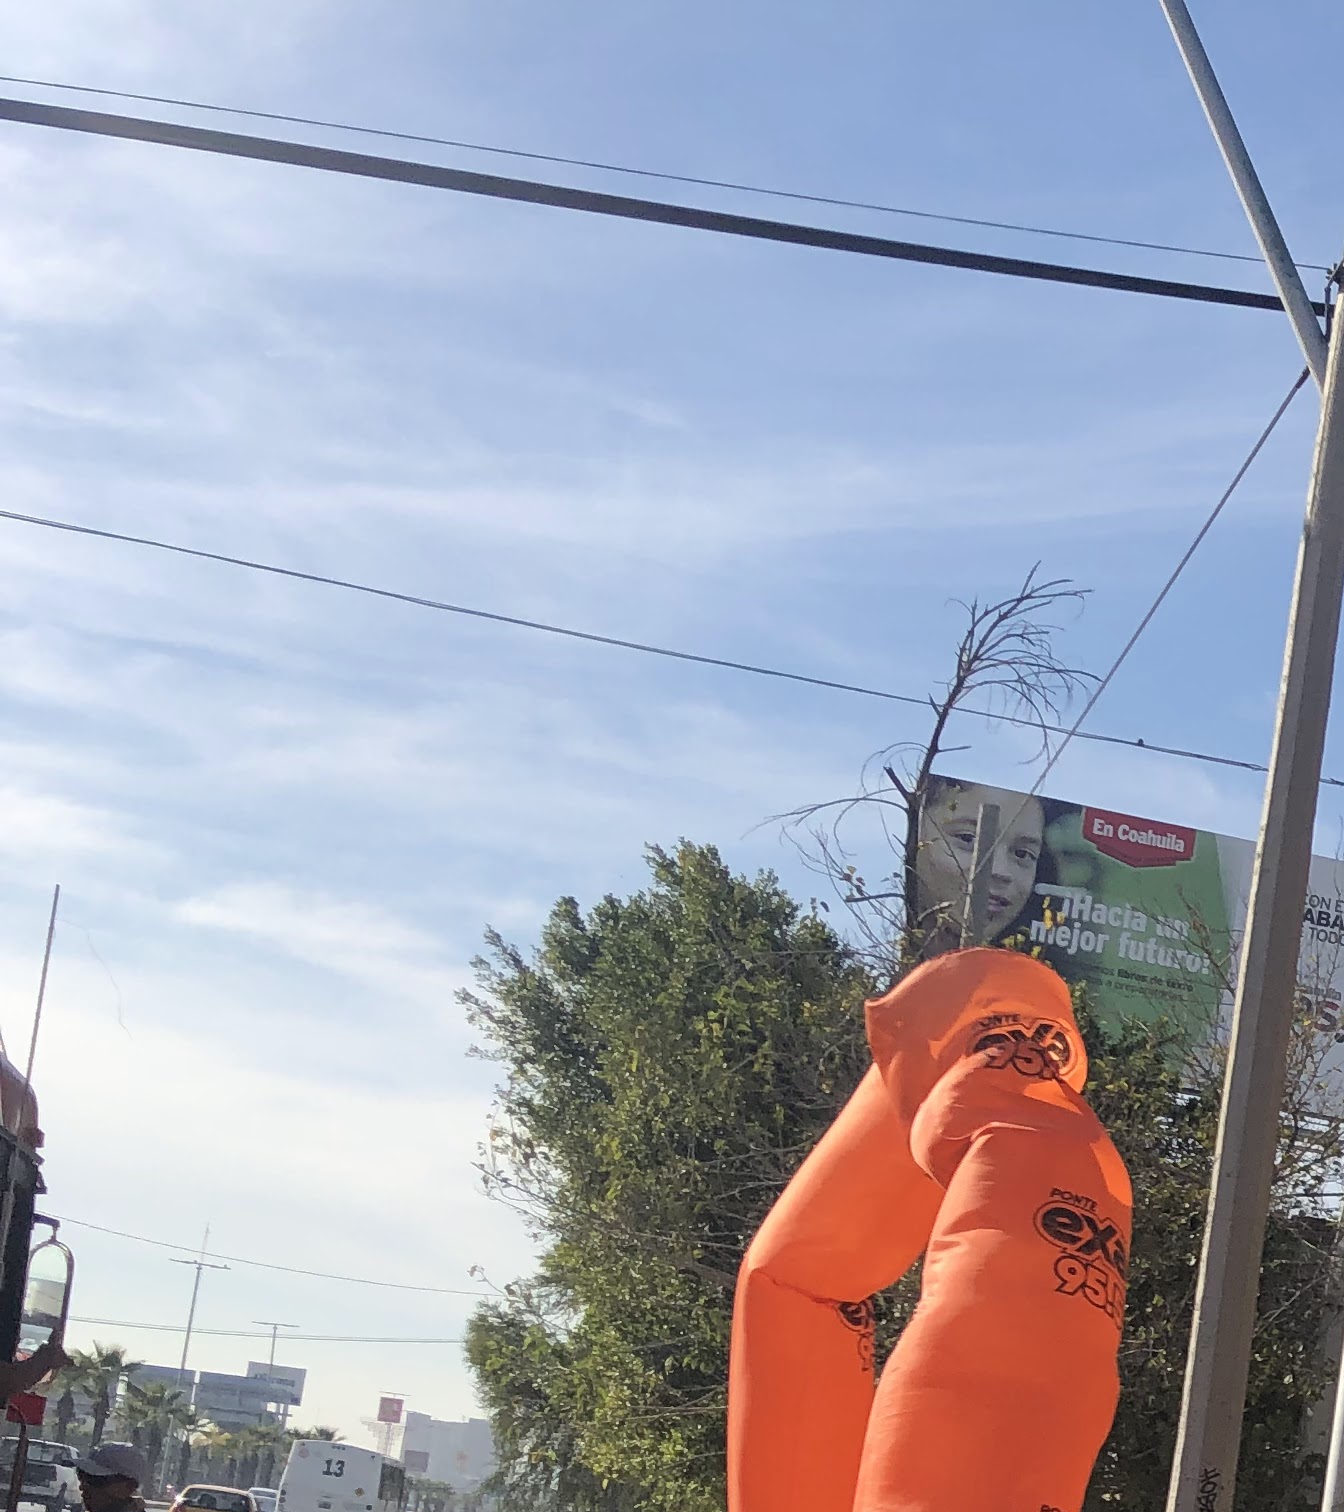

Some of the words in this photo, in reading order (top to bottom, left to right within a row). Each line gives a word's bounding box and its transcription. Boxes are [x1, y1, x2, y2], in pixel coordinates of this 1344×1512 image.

[1092, 818, 1114, 837] En
[1117, 824, 1185, 852] Coahuila
[1030, 920, 1110, 955] mejor
[1156, 915, 1188, 941] un
[1050, 1187, 1098, 1212] PONTE
[322, 1458, 345, 1478] 13
